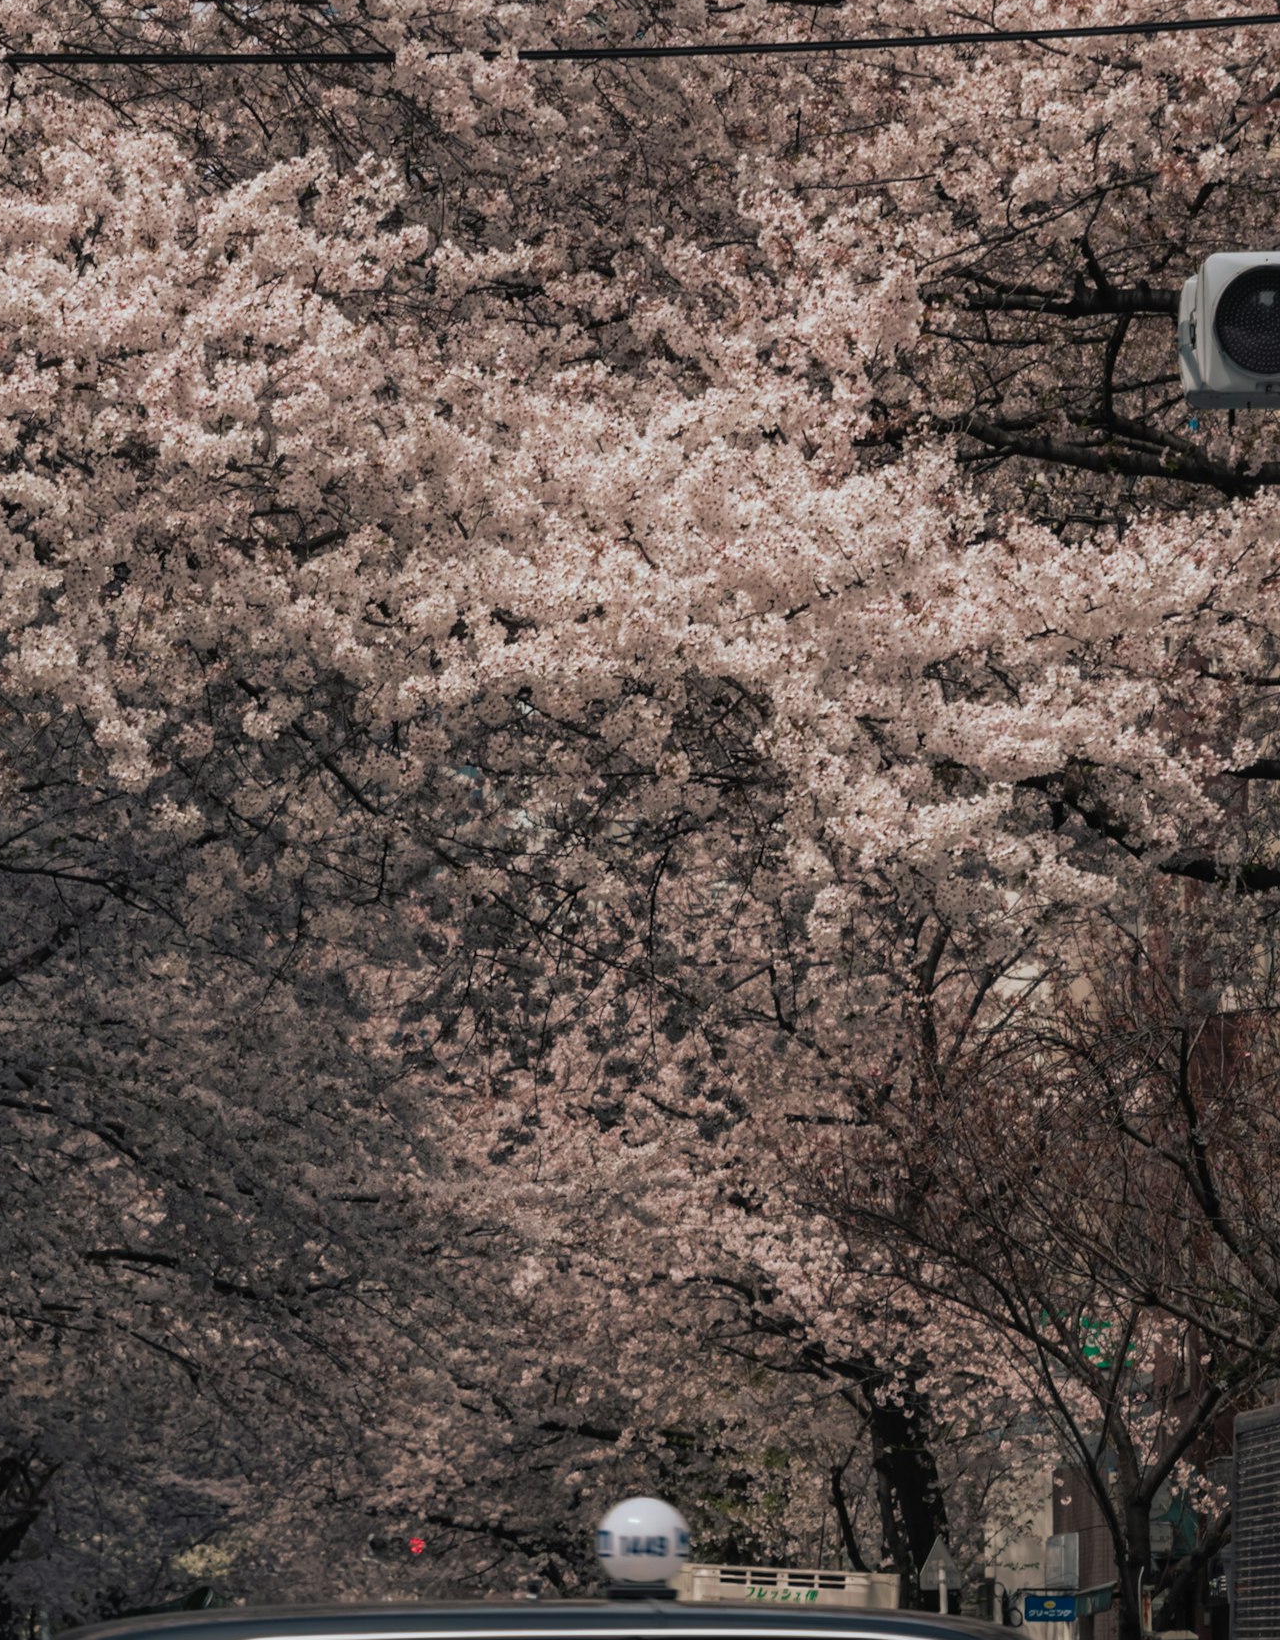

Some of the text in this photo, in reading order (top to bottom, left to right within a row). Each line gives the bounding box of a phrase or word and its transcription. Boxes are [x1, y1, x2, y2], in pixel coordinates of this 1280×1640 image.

[745, 1586, 819, 1603] フレッシュ便
[1027, 1609, 1072, 1617] クリーニング
